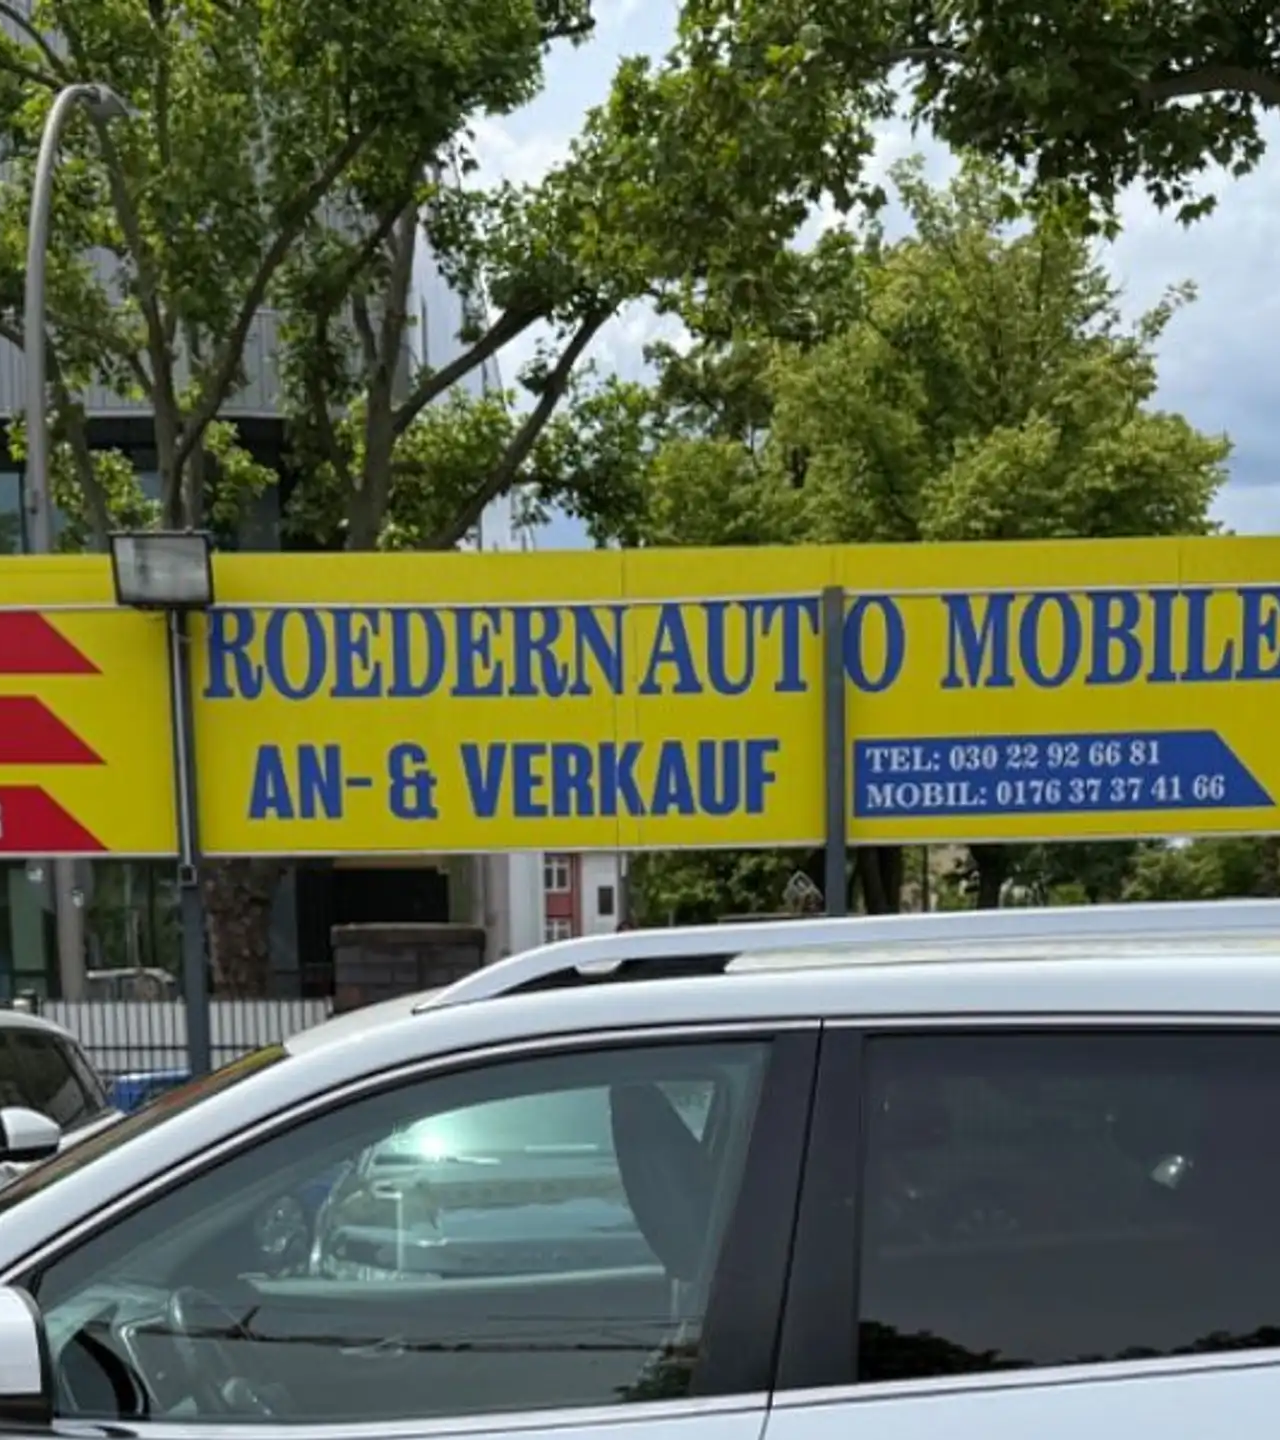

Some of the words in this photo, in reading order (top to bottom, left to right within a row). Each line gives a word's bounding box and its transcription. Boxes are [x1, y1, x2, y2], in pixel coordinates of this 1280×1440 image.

[865, 747, 941, 773] TEL:
[948, 745, 998, 771] 030
[1005, 743, 1039, 769] 22
[1046, 742, 1080, 768] 92
[1088, 740, 1121, 766] 66
[1129, 739, 1160, 766] 81
[248, 744, 373, 819] AN-
[388, 742, 438, 819] &
[460, 738, 780, 817] VERKAUF
[866, 782, 988, 809] MOBIL:
[996, 779, 1062, 806] 0176
[1069, 778, 1102, 804] 37
[1110, 777, 1143, 802] 37
[1150, 775, 1183, 801] 41
[1192, 774, 1226, 800] 66
